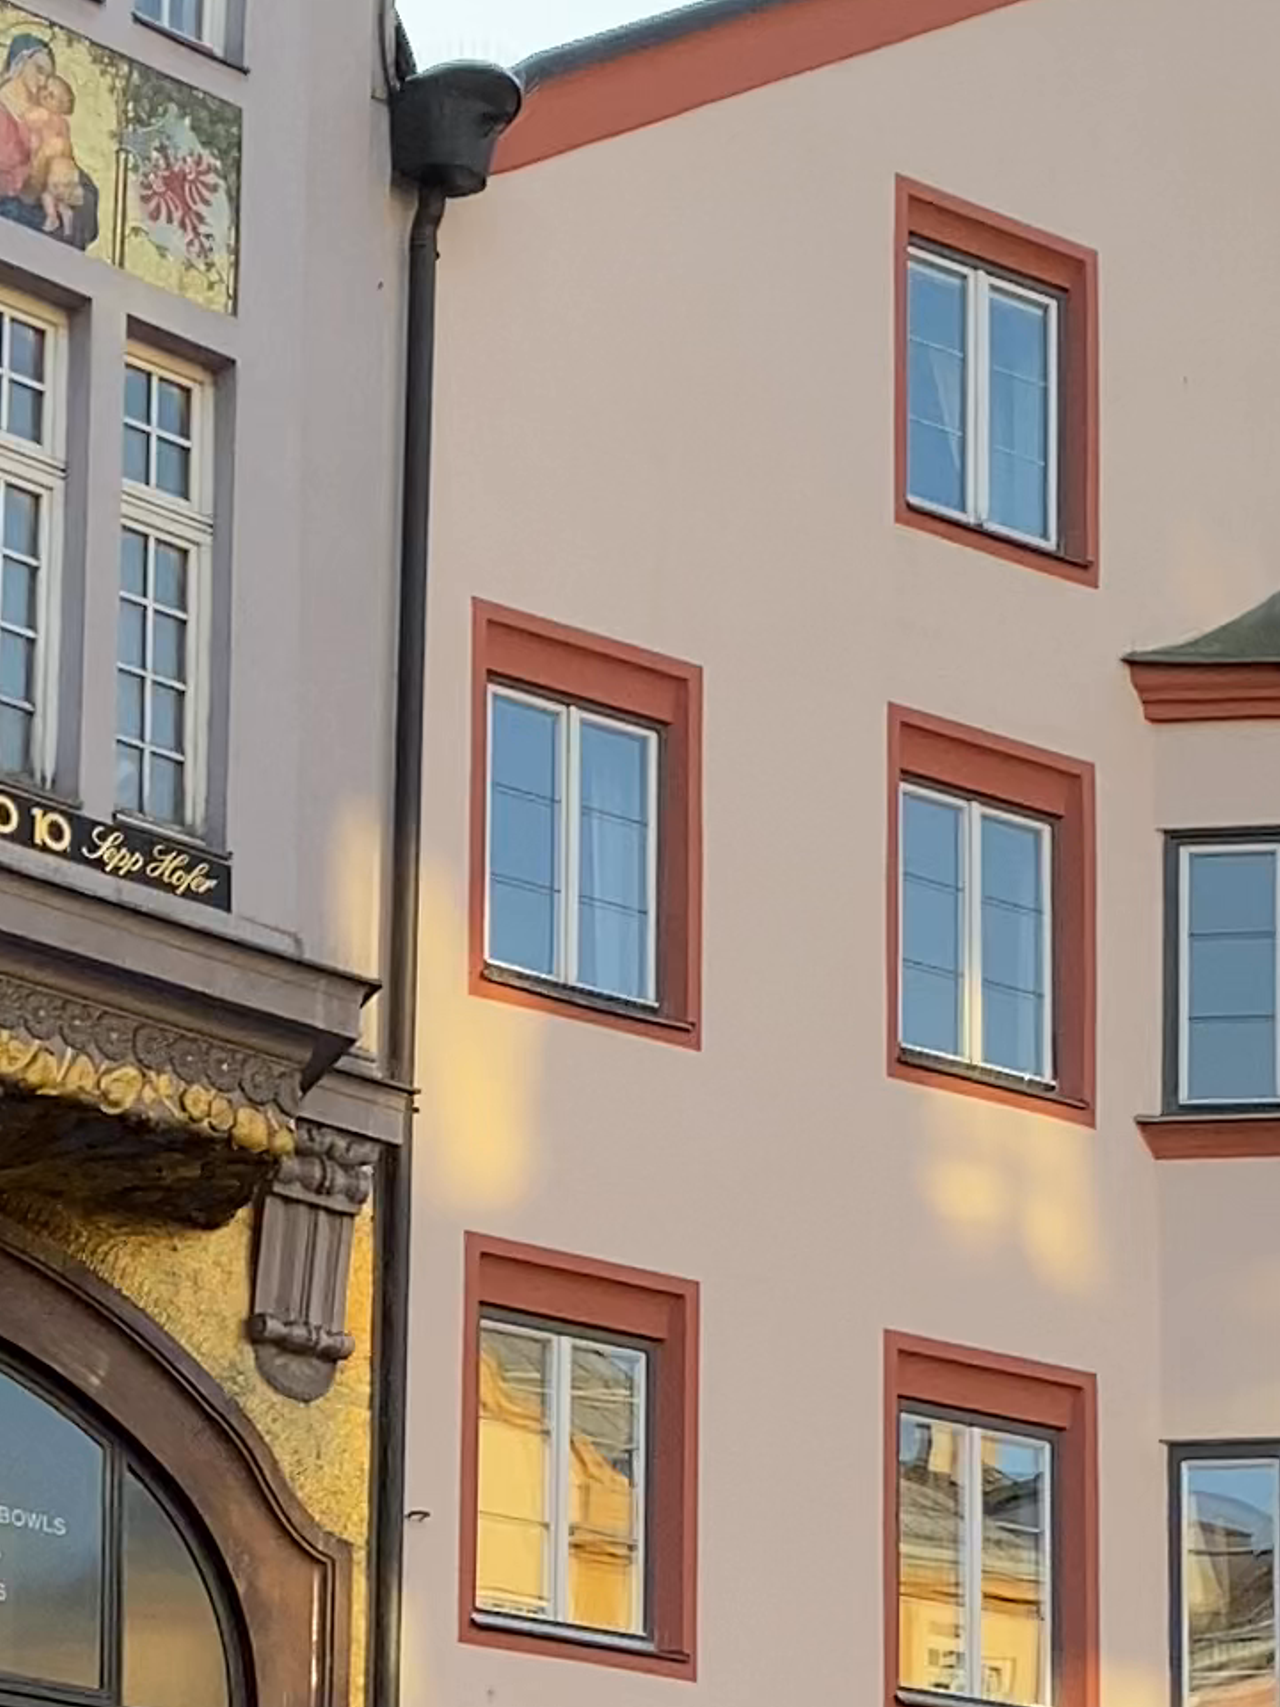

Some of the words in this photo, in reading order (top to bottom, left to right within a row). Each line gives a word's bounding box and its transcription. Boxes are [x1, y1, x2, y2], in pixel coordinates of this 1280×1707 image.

[31, 806, 72, 853] 10
[82, 826, 143, 876] Sepp
[145, 844, 220, 896] Hofer
